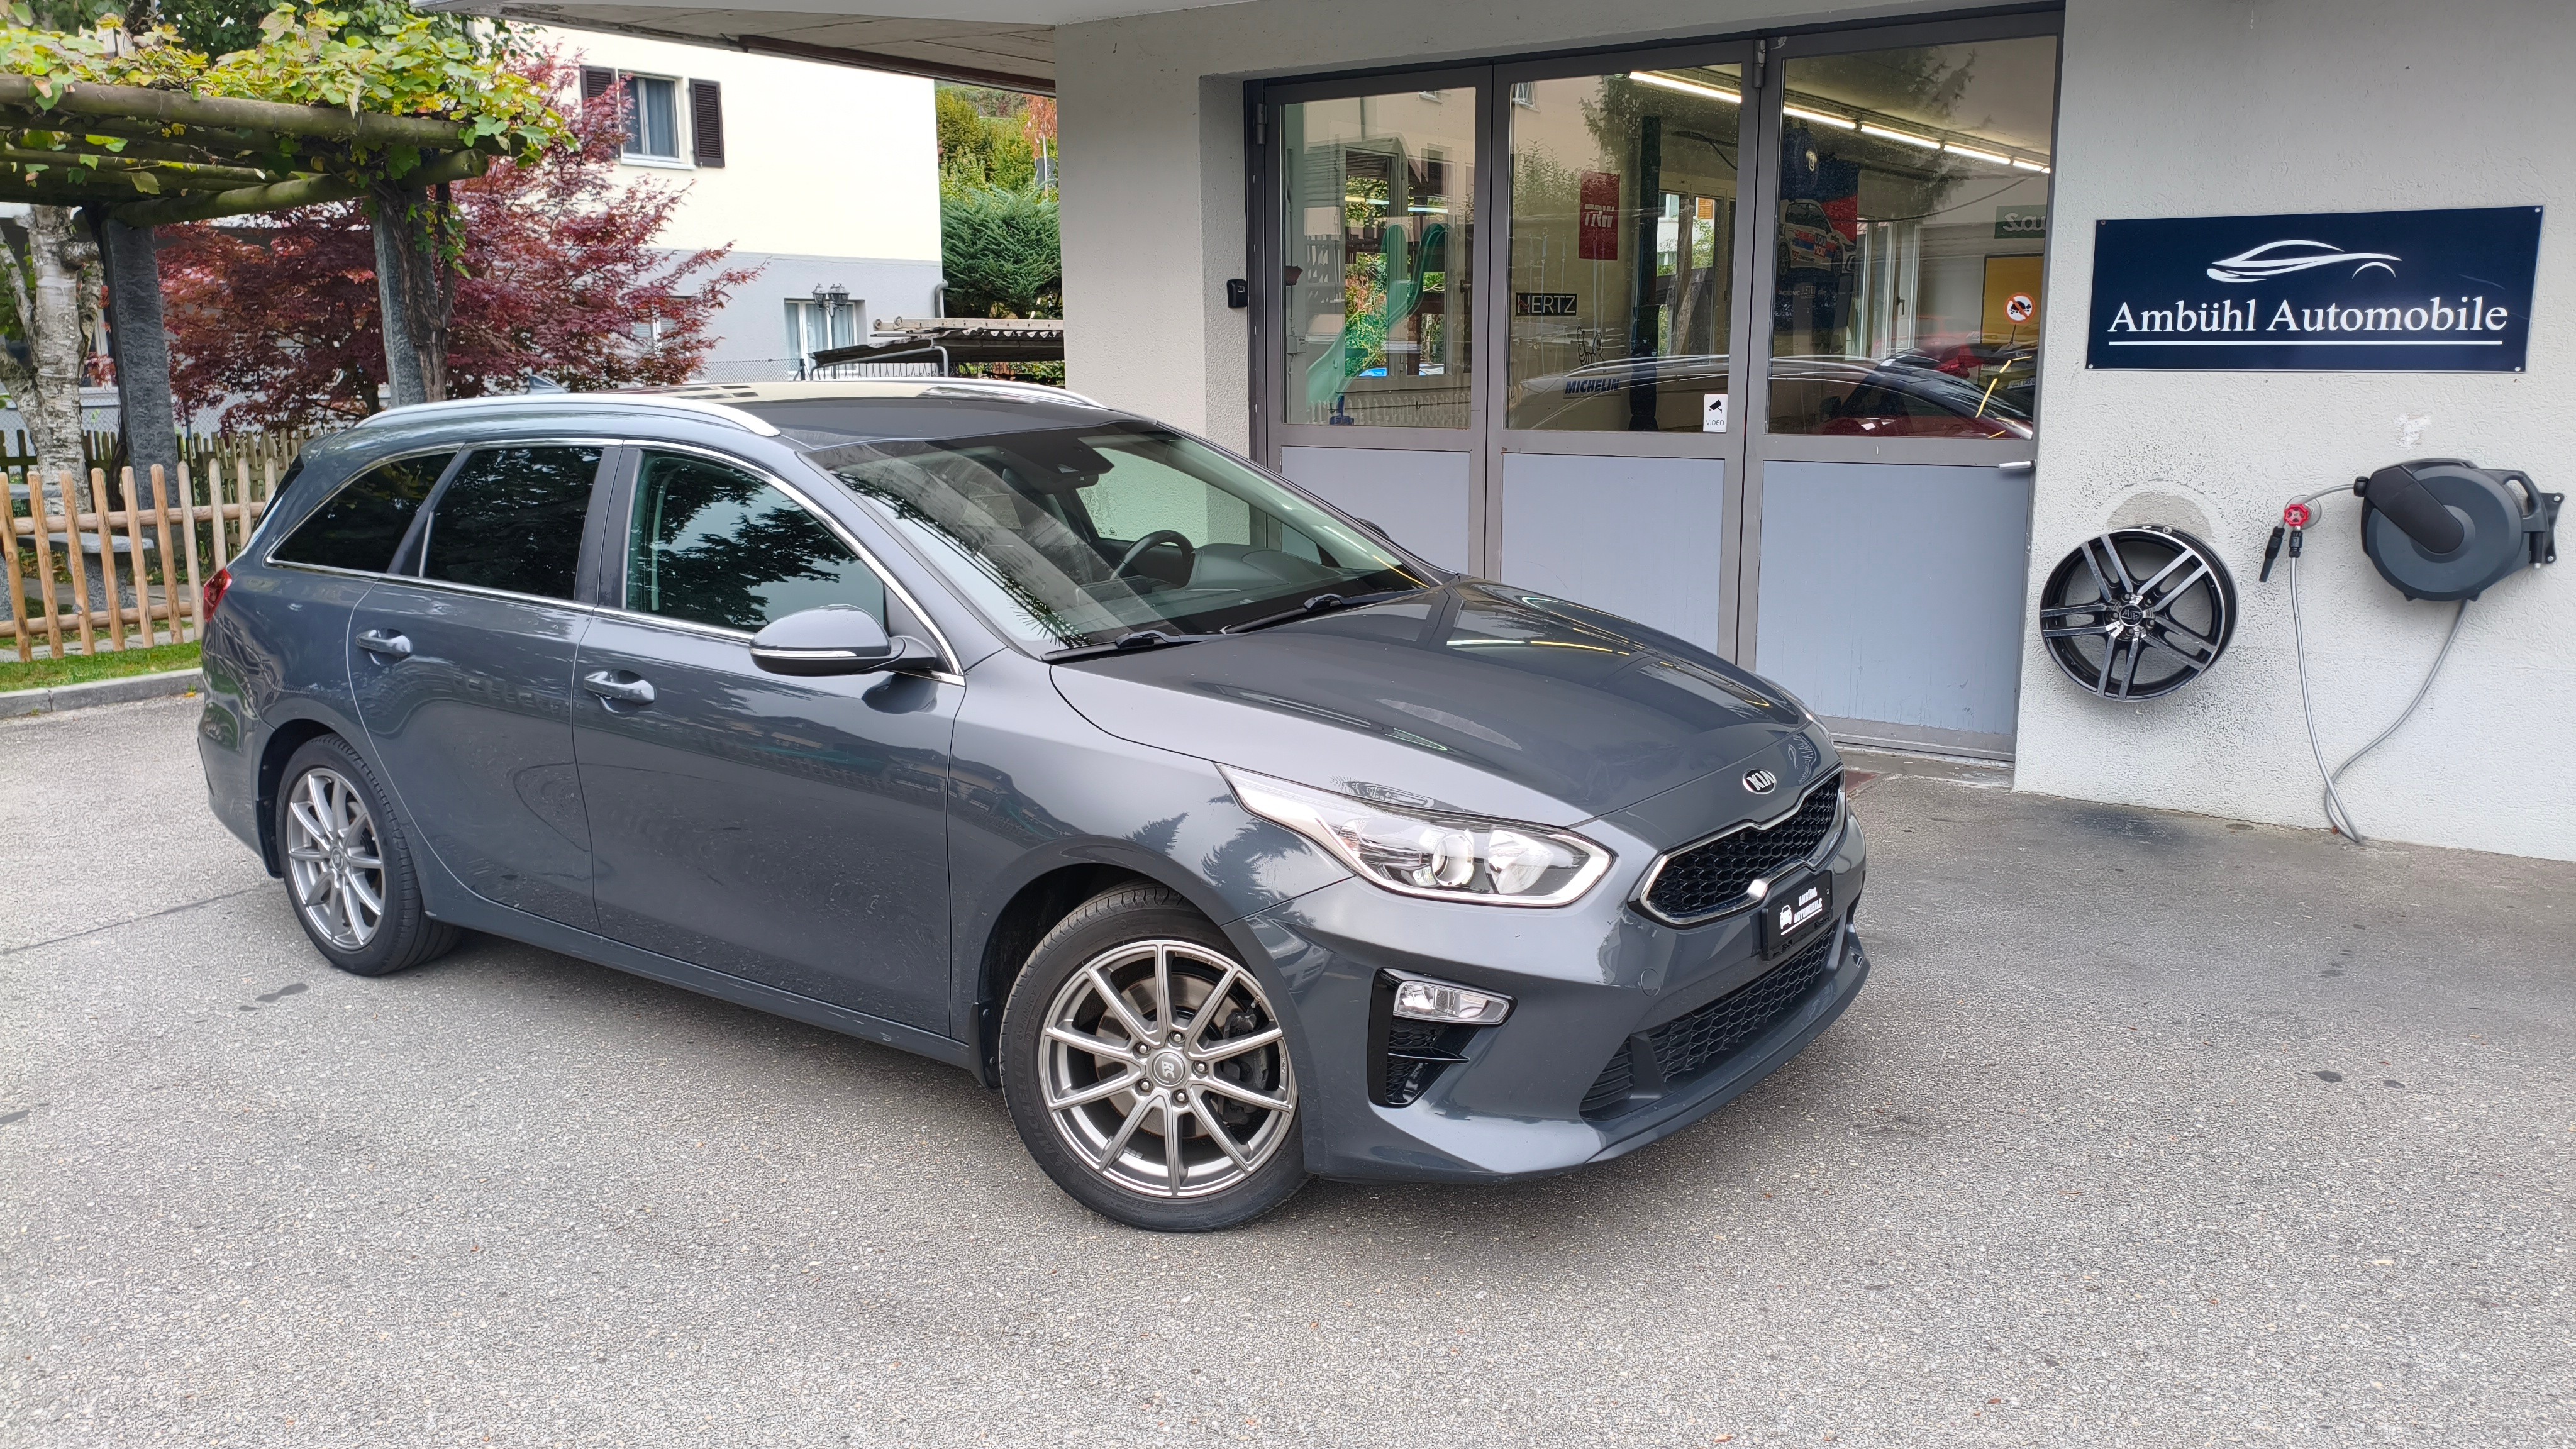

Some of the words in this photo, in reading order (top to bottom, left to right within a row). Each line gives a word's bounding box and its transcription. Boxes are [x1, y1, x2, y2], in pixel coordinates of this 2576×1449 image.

[1517, 295, 1576, 313] HERTZ
[2107, 299, 2257, 333] Ambühl
[2266, 296, 2508, 332] Automobile
[1565, 379, 1620, 394] MICHELIN
[1746, 770, 1774, 791] KIA
